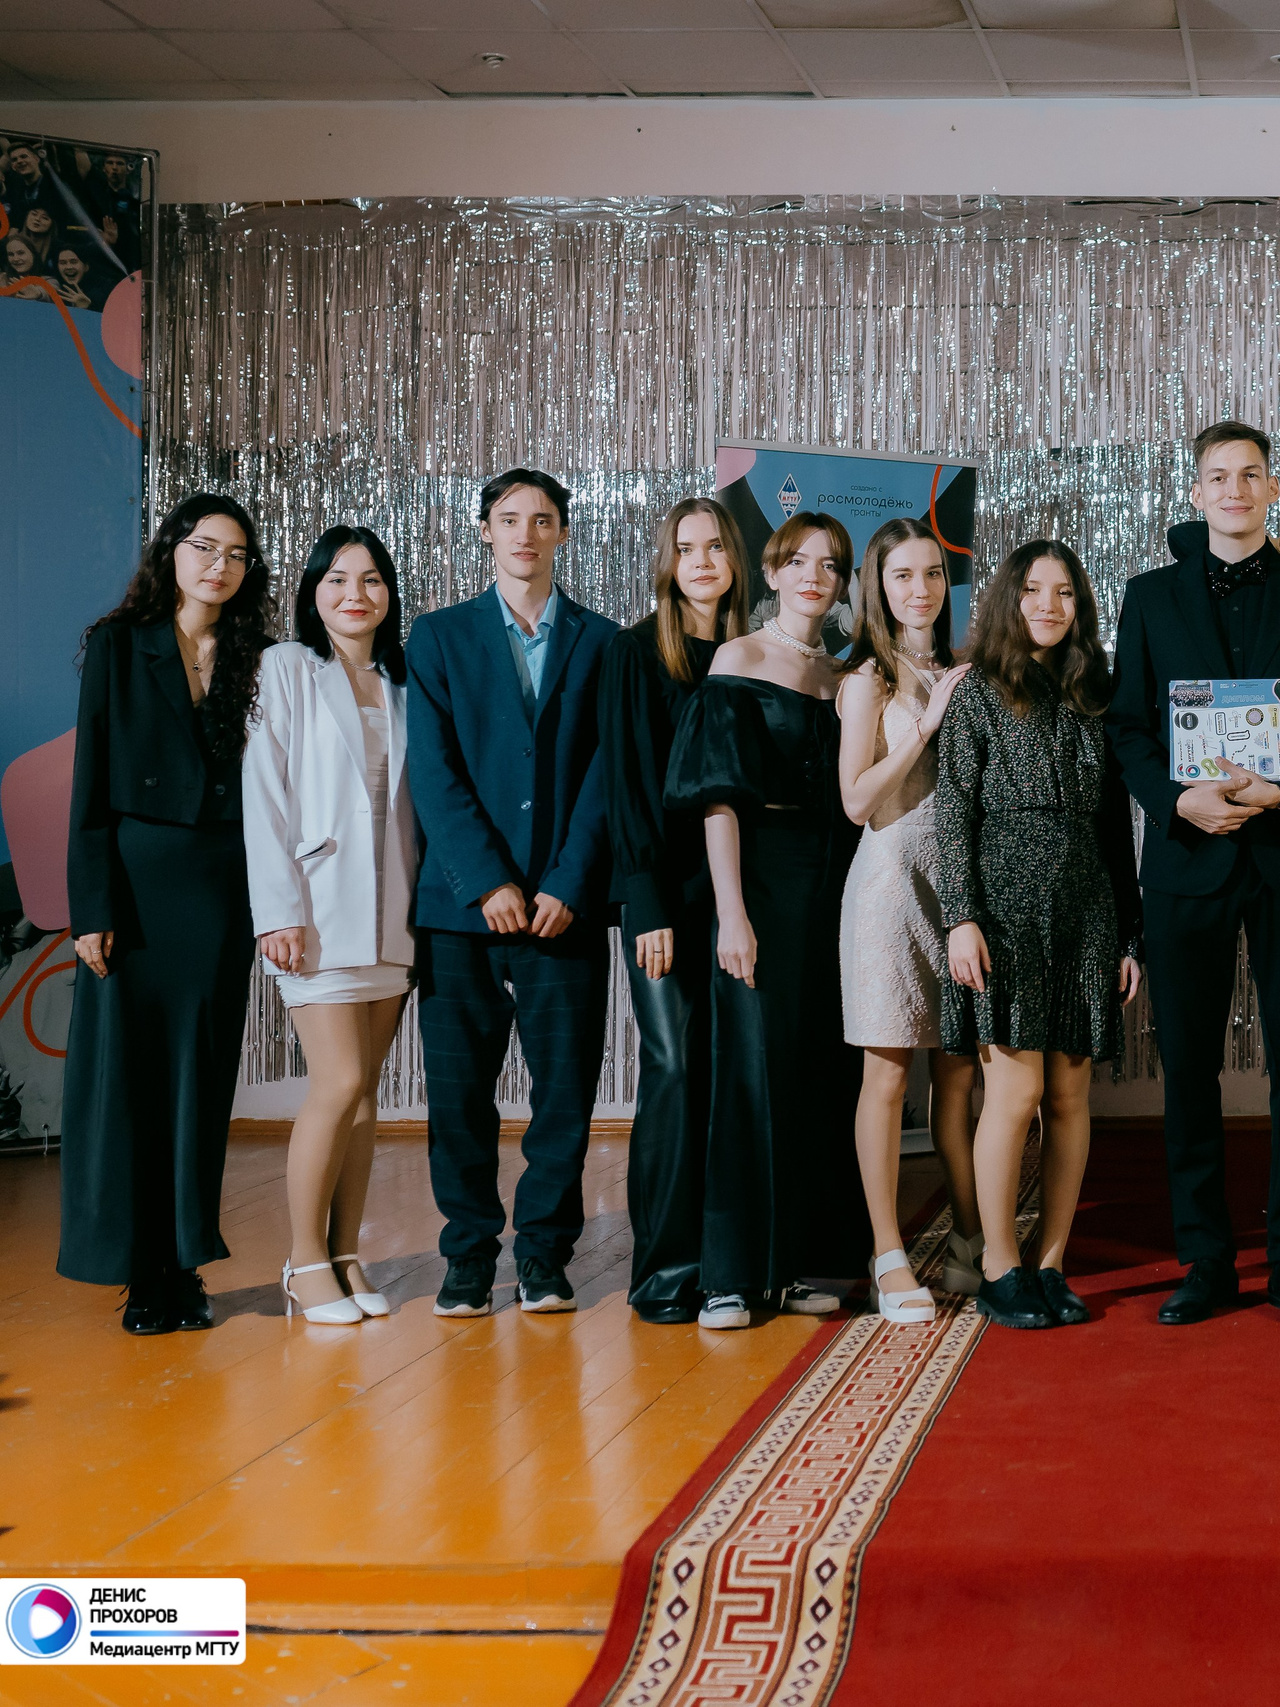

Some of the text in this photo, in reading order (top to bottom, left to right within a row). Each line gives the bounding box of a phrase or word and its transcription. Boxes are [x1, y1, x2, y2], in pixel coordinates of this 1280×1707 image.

[850, 484, 878, 492] создано
[817, 493, 914, 510] росмолодёжь
[850, 508, 882, 518] гранты
